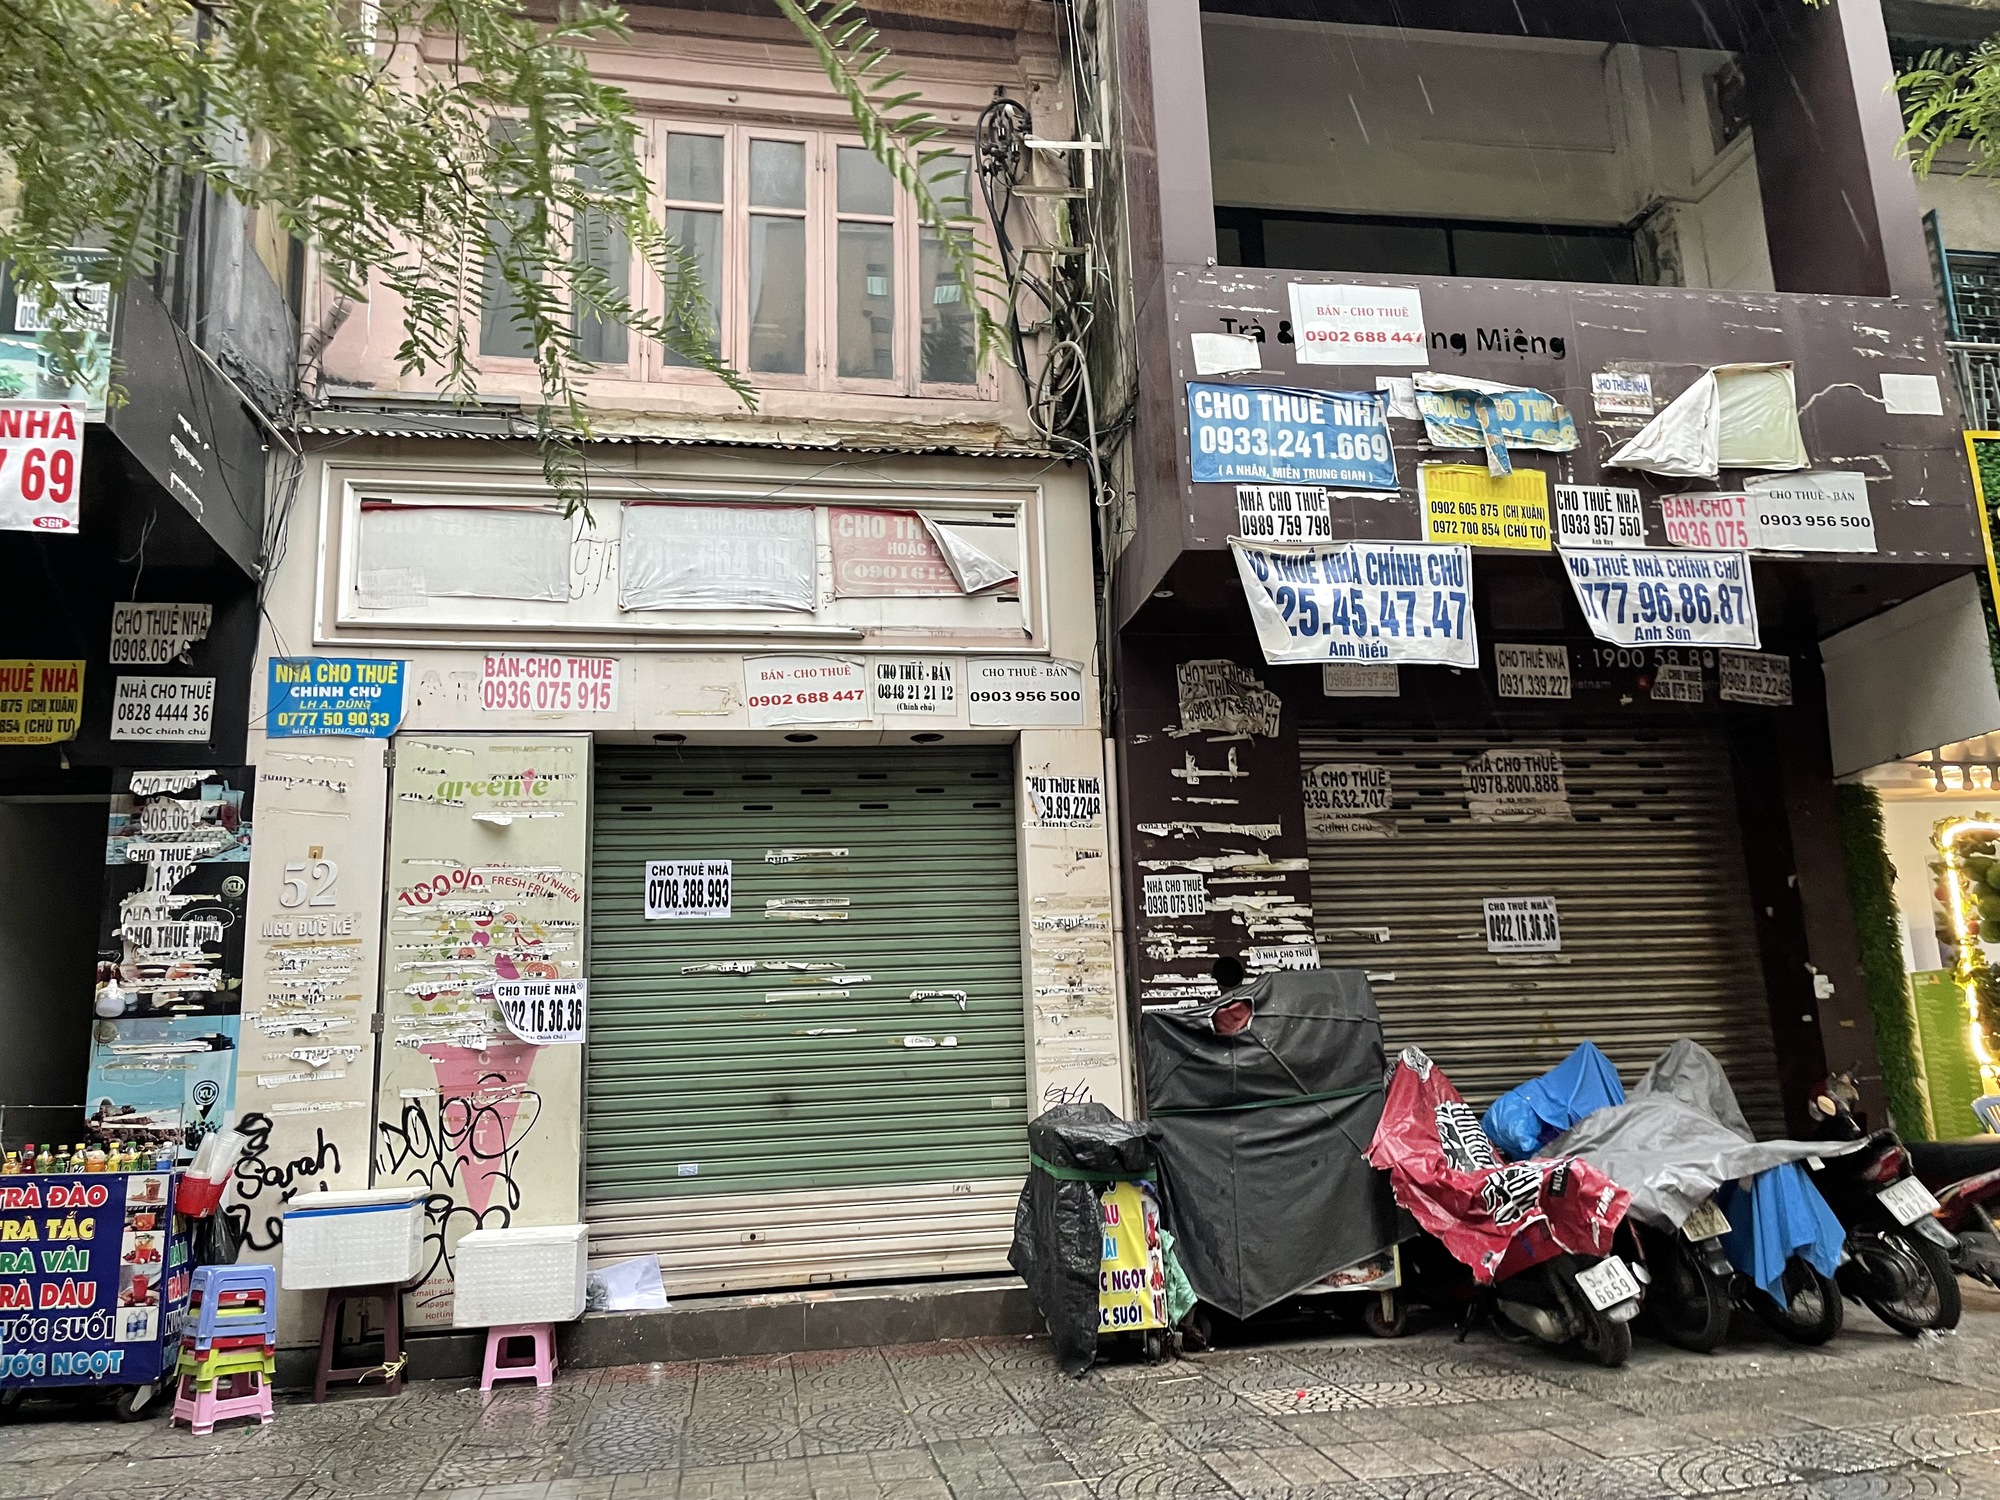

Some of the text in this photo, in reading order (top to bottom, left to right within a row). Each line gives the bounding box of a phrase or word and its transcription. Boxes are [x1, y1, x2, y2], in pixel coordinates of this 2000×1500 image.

[1316, 304, 1409, 318] BÁN CHO THUÊ
[1305, 328, 1350, 342] 0902
[1353, 330, 1387, 343] 688
[1476, 327, 1566, 361] Miệng
[1194, 390, 1250, 420] CHO
[1199, 424, 1389, 463] 0933.241.669
[20, 447, 74, 504] 69
[1303, 467, 1338, 481] TRUNG
[1341, 469, 1366, 481] GIAN
[1239, 487, 1327, 512] NHÀ CHO THUÊ
[1556, 487, 1640, 514] CHO THUÊ NHÀ
[1769, 490, 1792, 499] CHO
[1795, 488, 1825, 501] THUÊ
[1431, 501, 1456, 514] 0902
[1458, 502, 1477, 515] 605
[1480, 504, 1499, 517] 875
[39, 517, 64, 529] SGN
[838, 514, 887, 540] CHO
[1242, 515, 1331, 536] 0989 759 798
[1432, 519, 1458, 533] 0972
[1461, 521, 1479, 535] 700
[1481, 522, 1500, 537] 854
[1561, 513, 1641, 537] 0933 957 550
[1760, 514, 1871, 528] 0903 956 500
[1668, 519, 1748, 548] 0936 075
[887, 539, 927, 560] HOẶC
[1270, 545, 1465, 588] THUÊ NHÀ CHÍNH CHỦ
[1593, 554, 1630, 578] THUÊ
[1633, 555, 1664, 578] NHÀ
[1667, 555, 1711, 579] CHÍNH
[114, 609, 142, 635] CHO
[146, 604, 179, 636] THUÊ
[1634, 625, 1691, 641] Anh Sơn
[1328, 640, 1355, 657] Anh
[1499, 650, 1519, 668] CHO
[1593, 649, 1645, 668] 1900
[316, 661, 398, 684] CHO THUÊ
[484, 652, 562, 679] BÁN-CHO
[761, 665, 852, 681] BÁN CHO THUÊ
[877, 663, 897, 680] CHO
[932, 661, 951, 681] BÁN
[982, 668, 1005, 677] CHO
[1007, 667, 1038, 678] THUÊ
[40, 662, 79, 693] NHÀ
[1500, 673, 1569, 696] 0931.339.227
[120, 679, 212, 700] NHÀ CHO THUÊ
[290, 684, 382, 698] CHÍNH CHỦ
[484, 680, 611, 710] 0936 075 915
[748, 689, 865, 708] 0902 688 447
[877, 684, 954, 701] 0848 21 21 12
[970, 690, 1081, 702] 0903 956 500
[118, 703, 209, 722] 0828 4444 36
[299, 700, 317, 709] LH
[277, 712, 344, 726] 0777 50
[1495, 757, 1521, 772] CHO
[1321, 771, 1348, 788] CHO
[651, 862, 729, 876] CHO THUÊ NHÀ
[280, 859, 339, 908] 52
[491, 876, 527, 889] FRESH
[1146, 877, 1203, 894] NHÀ CHO THUÊ
[649, 878, 730, 909] 0708.388.993
[1147, 894, 1204, 915] 0936 075 915
[498, 982, 577, 997] CHO THUÊ NHÀ
[234, 1127, 342, 1200] Sarah
[48, 1181, 110, 1208] ĐÀO
[46, 1211, 96, 1242] TẮC
[41, 1245, 91, 1274] VẢI
[1112, 1268, 1147, 1296] NGỌT
[39, 1278, 98, 1310] DÂU
[1112, 1302, 1143, 1324] SUỐI
[52, 1309, 116, 1341] SUỐI
[51, 1349, 125, 1380] NGỌT
